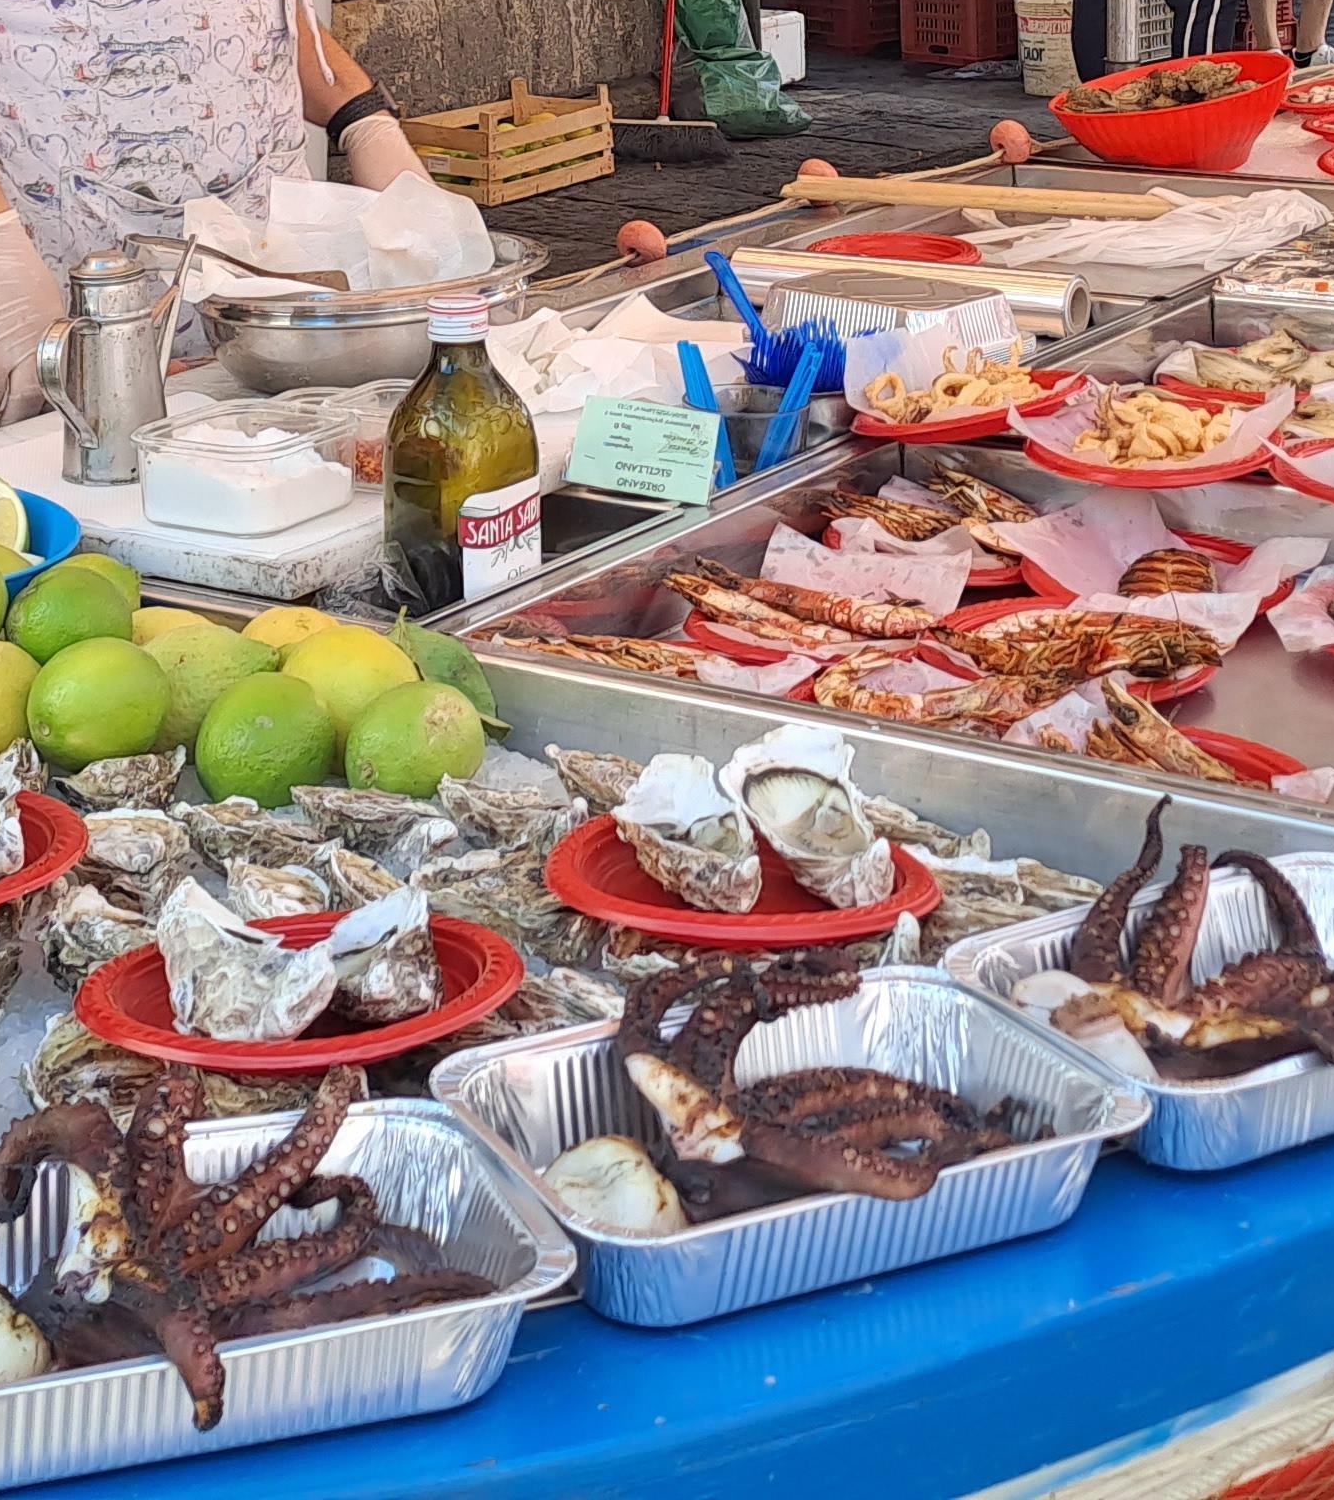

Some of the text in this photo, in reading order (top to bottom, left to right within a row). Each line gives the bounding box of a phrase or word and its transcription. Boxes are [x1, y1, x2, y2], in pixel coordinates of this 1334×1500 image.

[615, 460, 673, 478] SICILIANO
[616, 476, 666, 493] ORIGANO
[465, 495, 541, 546] SANTA SABI
